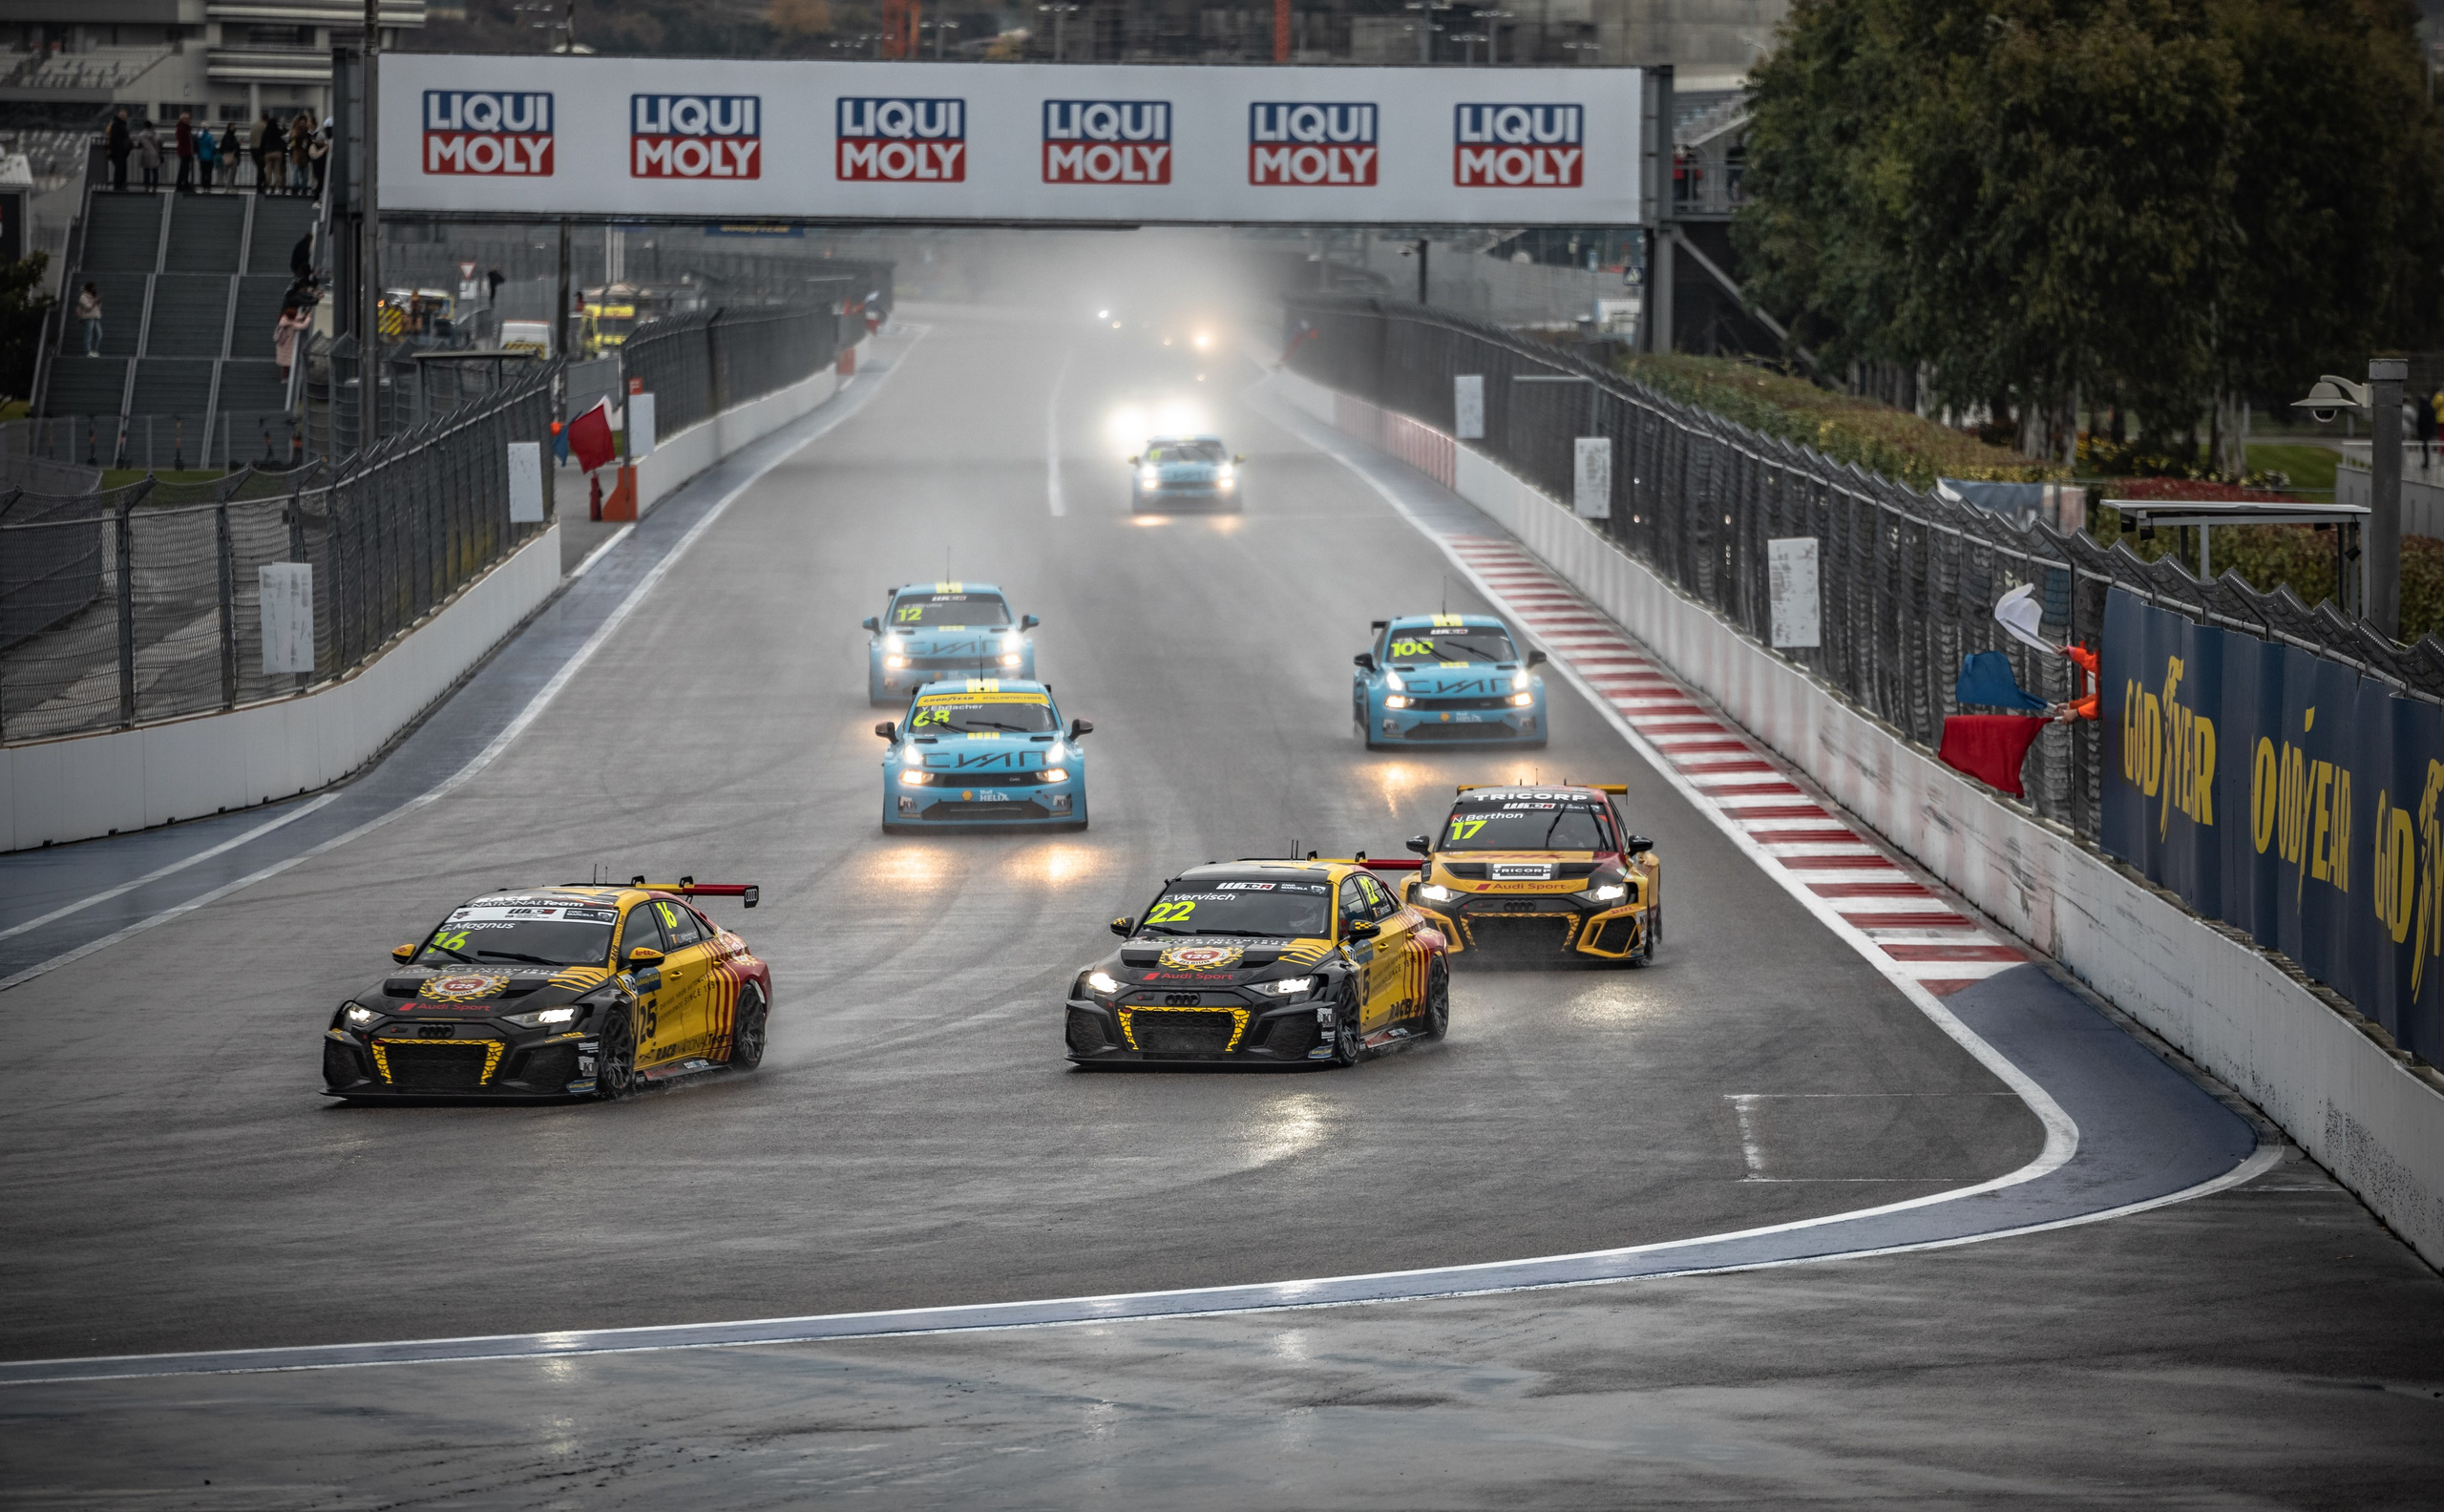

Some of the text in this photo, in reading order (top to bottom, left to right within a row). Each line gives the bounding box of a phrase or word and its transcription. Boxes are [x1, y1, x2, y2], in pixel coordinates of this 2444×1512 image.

[429, 94, 548, 133] LIQUI
[635, 97, 755, 136] LIQUI
[842, 100, 961, 139] LIQUI
[1047, 103, 1166, 142] LIQUI
[1254, 105, 1374, 144] LIQUI
[1459, 107, 1576, 145] LIQUI
[429, 136, 553, 173] MOLY
[635, 139, 759, 177] MOLY
[841, 142, 963, 179] MOLY
[1047, 145, 1170, 181] MOLY
[1254, 147, 1377, 183] MOLY
[1458, 148, 1581, 185] MOLY
[897, 608, 923, 622] 12
[1390, 641, 1435, 658] 100
[913, 710, 951, 727] 68
[980, 793, 1009, 802] HELIX
[1474, 793, 1588, 802] TRICORP
[1450, 820, 1488, 841] 17
[1359, 876, 1380, 905] 22
[1528, 883, 1567, 892] Sport
[656, 901, 678, 929] 16
[1144, 901, 1196, 925] 22
[426, 931, 471, 955] 16
[1161, 972, 1233, 981] Audi Sport
[417, 1002, 492, 1012] Audi Sport
